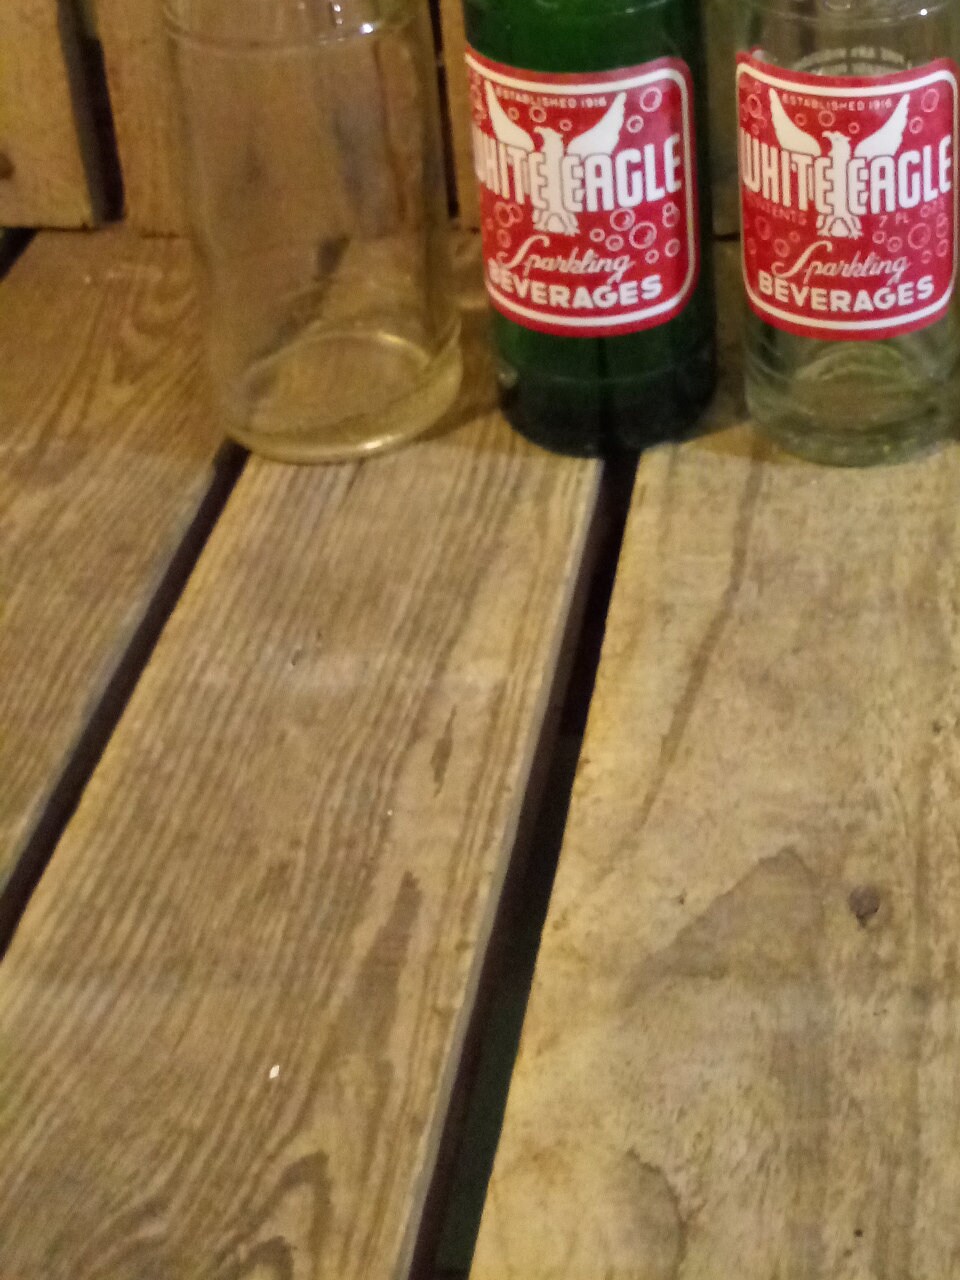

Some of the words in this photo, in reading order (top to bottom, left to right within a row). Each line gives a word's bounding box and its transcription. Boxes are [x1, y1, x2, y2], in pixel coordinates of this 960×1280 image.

[560, 133, 682, 213] EAGLE
[738, 126, 834, 214] WHITE
[849, 133, 952, 215] EAGLE
[487, 257, 663, 309] BEVERAGES
[496, 234, 635, 285] Sparkling
[771, 240, 911, 285] Sparkling
[757, 269, 935, 313] BEVERAGES
